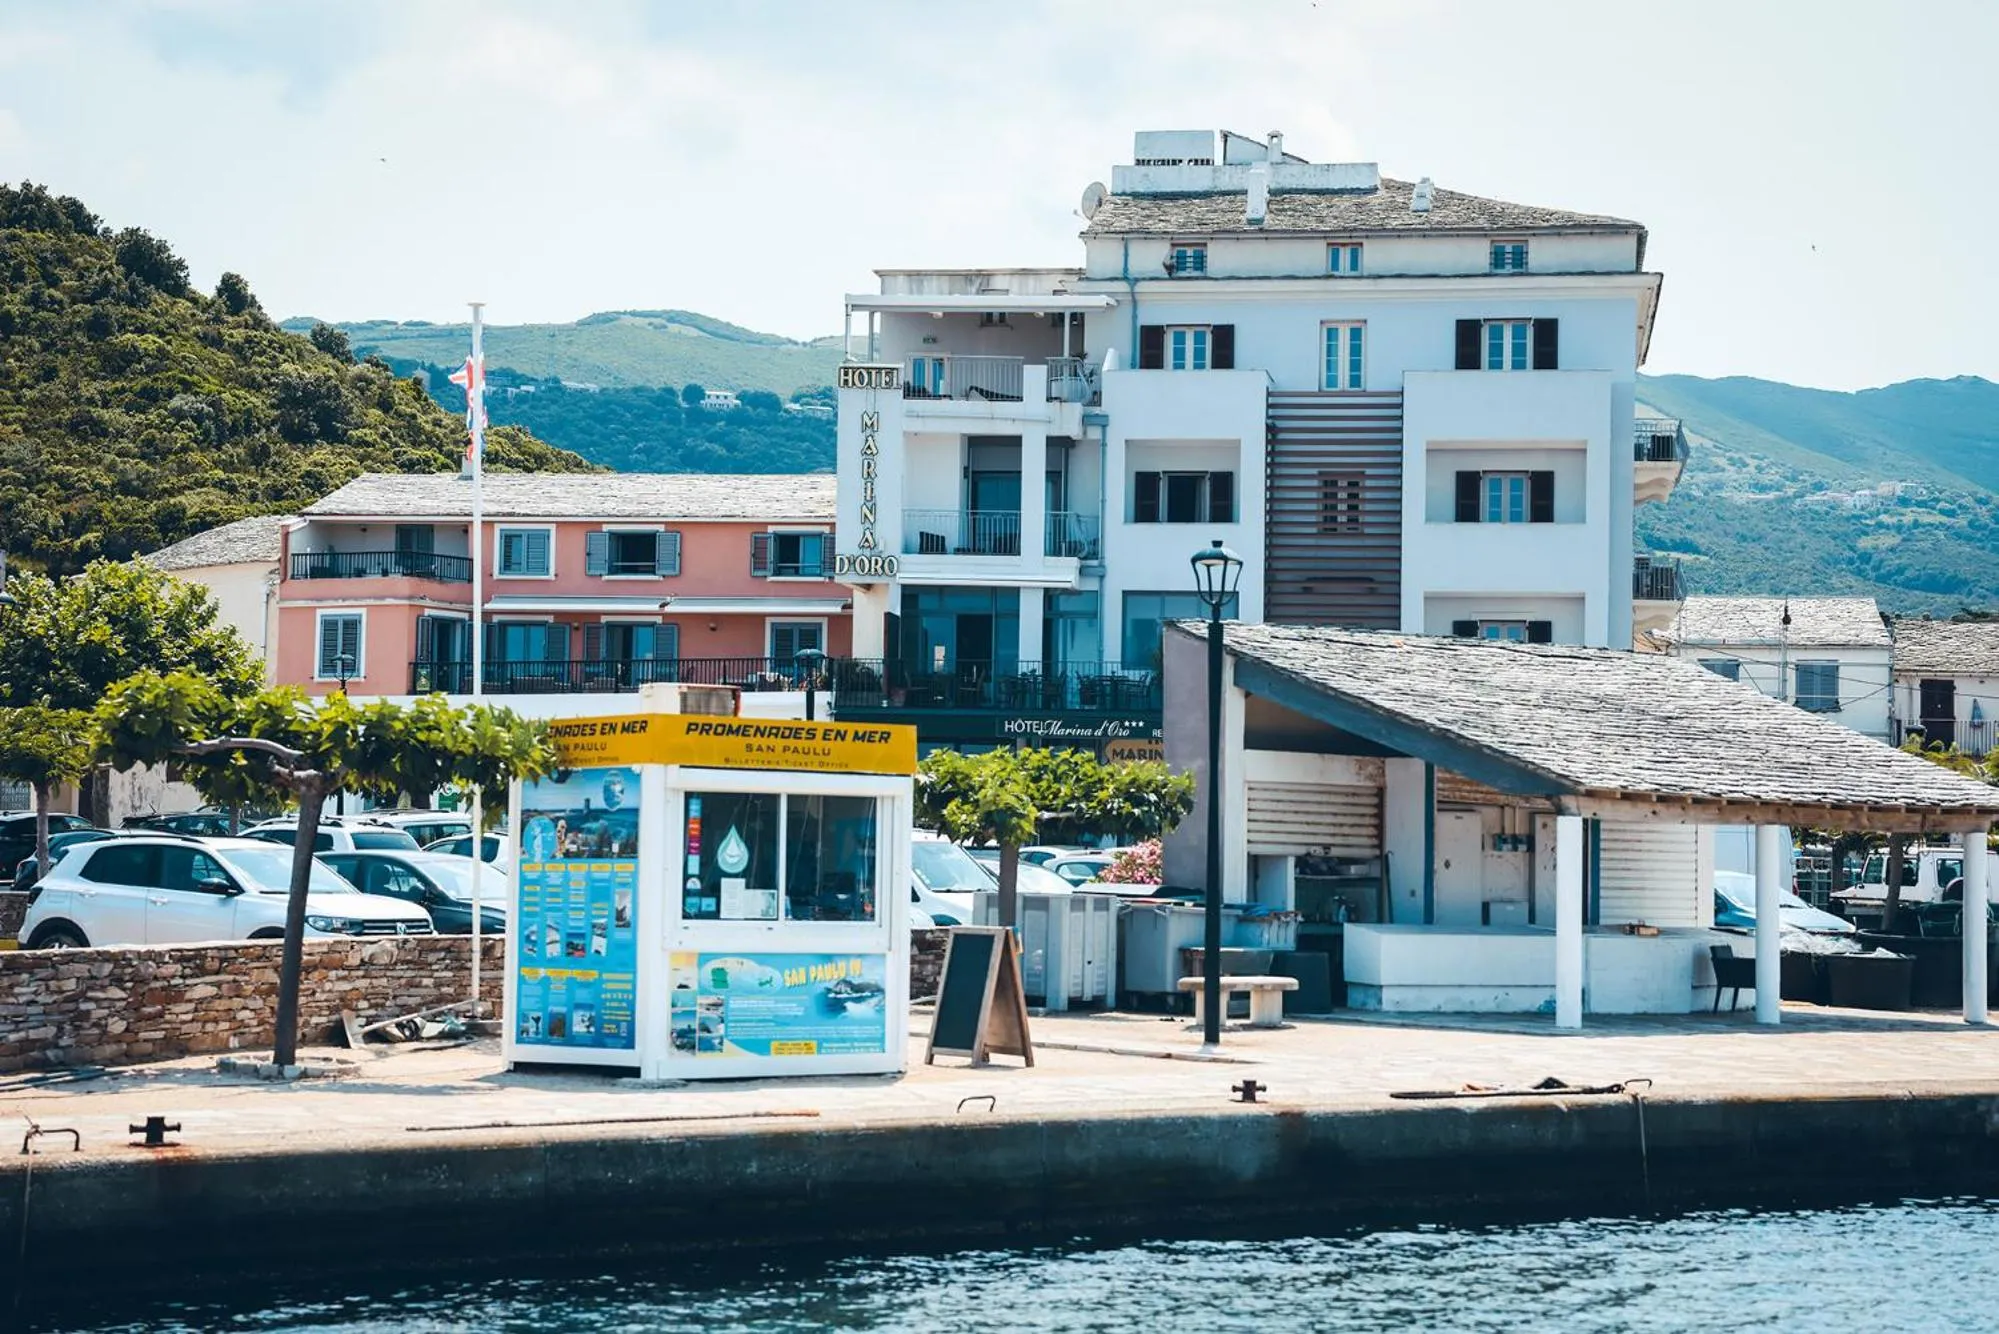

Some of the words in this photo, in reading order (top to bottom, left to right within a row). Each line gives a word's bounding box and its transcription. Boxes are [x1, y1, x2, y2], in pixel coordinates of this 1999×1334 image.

[838, 367, 902, 389] HOTEL
[858, 410, 879, 550] MARINA
[835, 554, 899, 577] D'ORO
[599, 722, 619, 736] EN
[620, 720, 648, 734] MER
[685, 722, 817, 741] PROMENADES
[822, 728, 848, 743] EN
[851, 730, 892, 744] MER
[1004, 718, 1045, 733] HÔTEL
[1039, 719, 1092, 737] Marina
[1093, 719, 1131, 737] d'Oro
[573, 741, 608, 752] PAULU
[745, 743, 777, 754] SAN
[783, 745, 832, 757] PAULU
